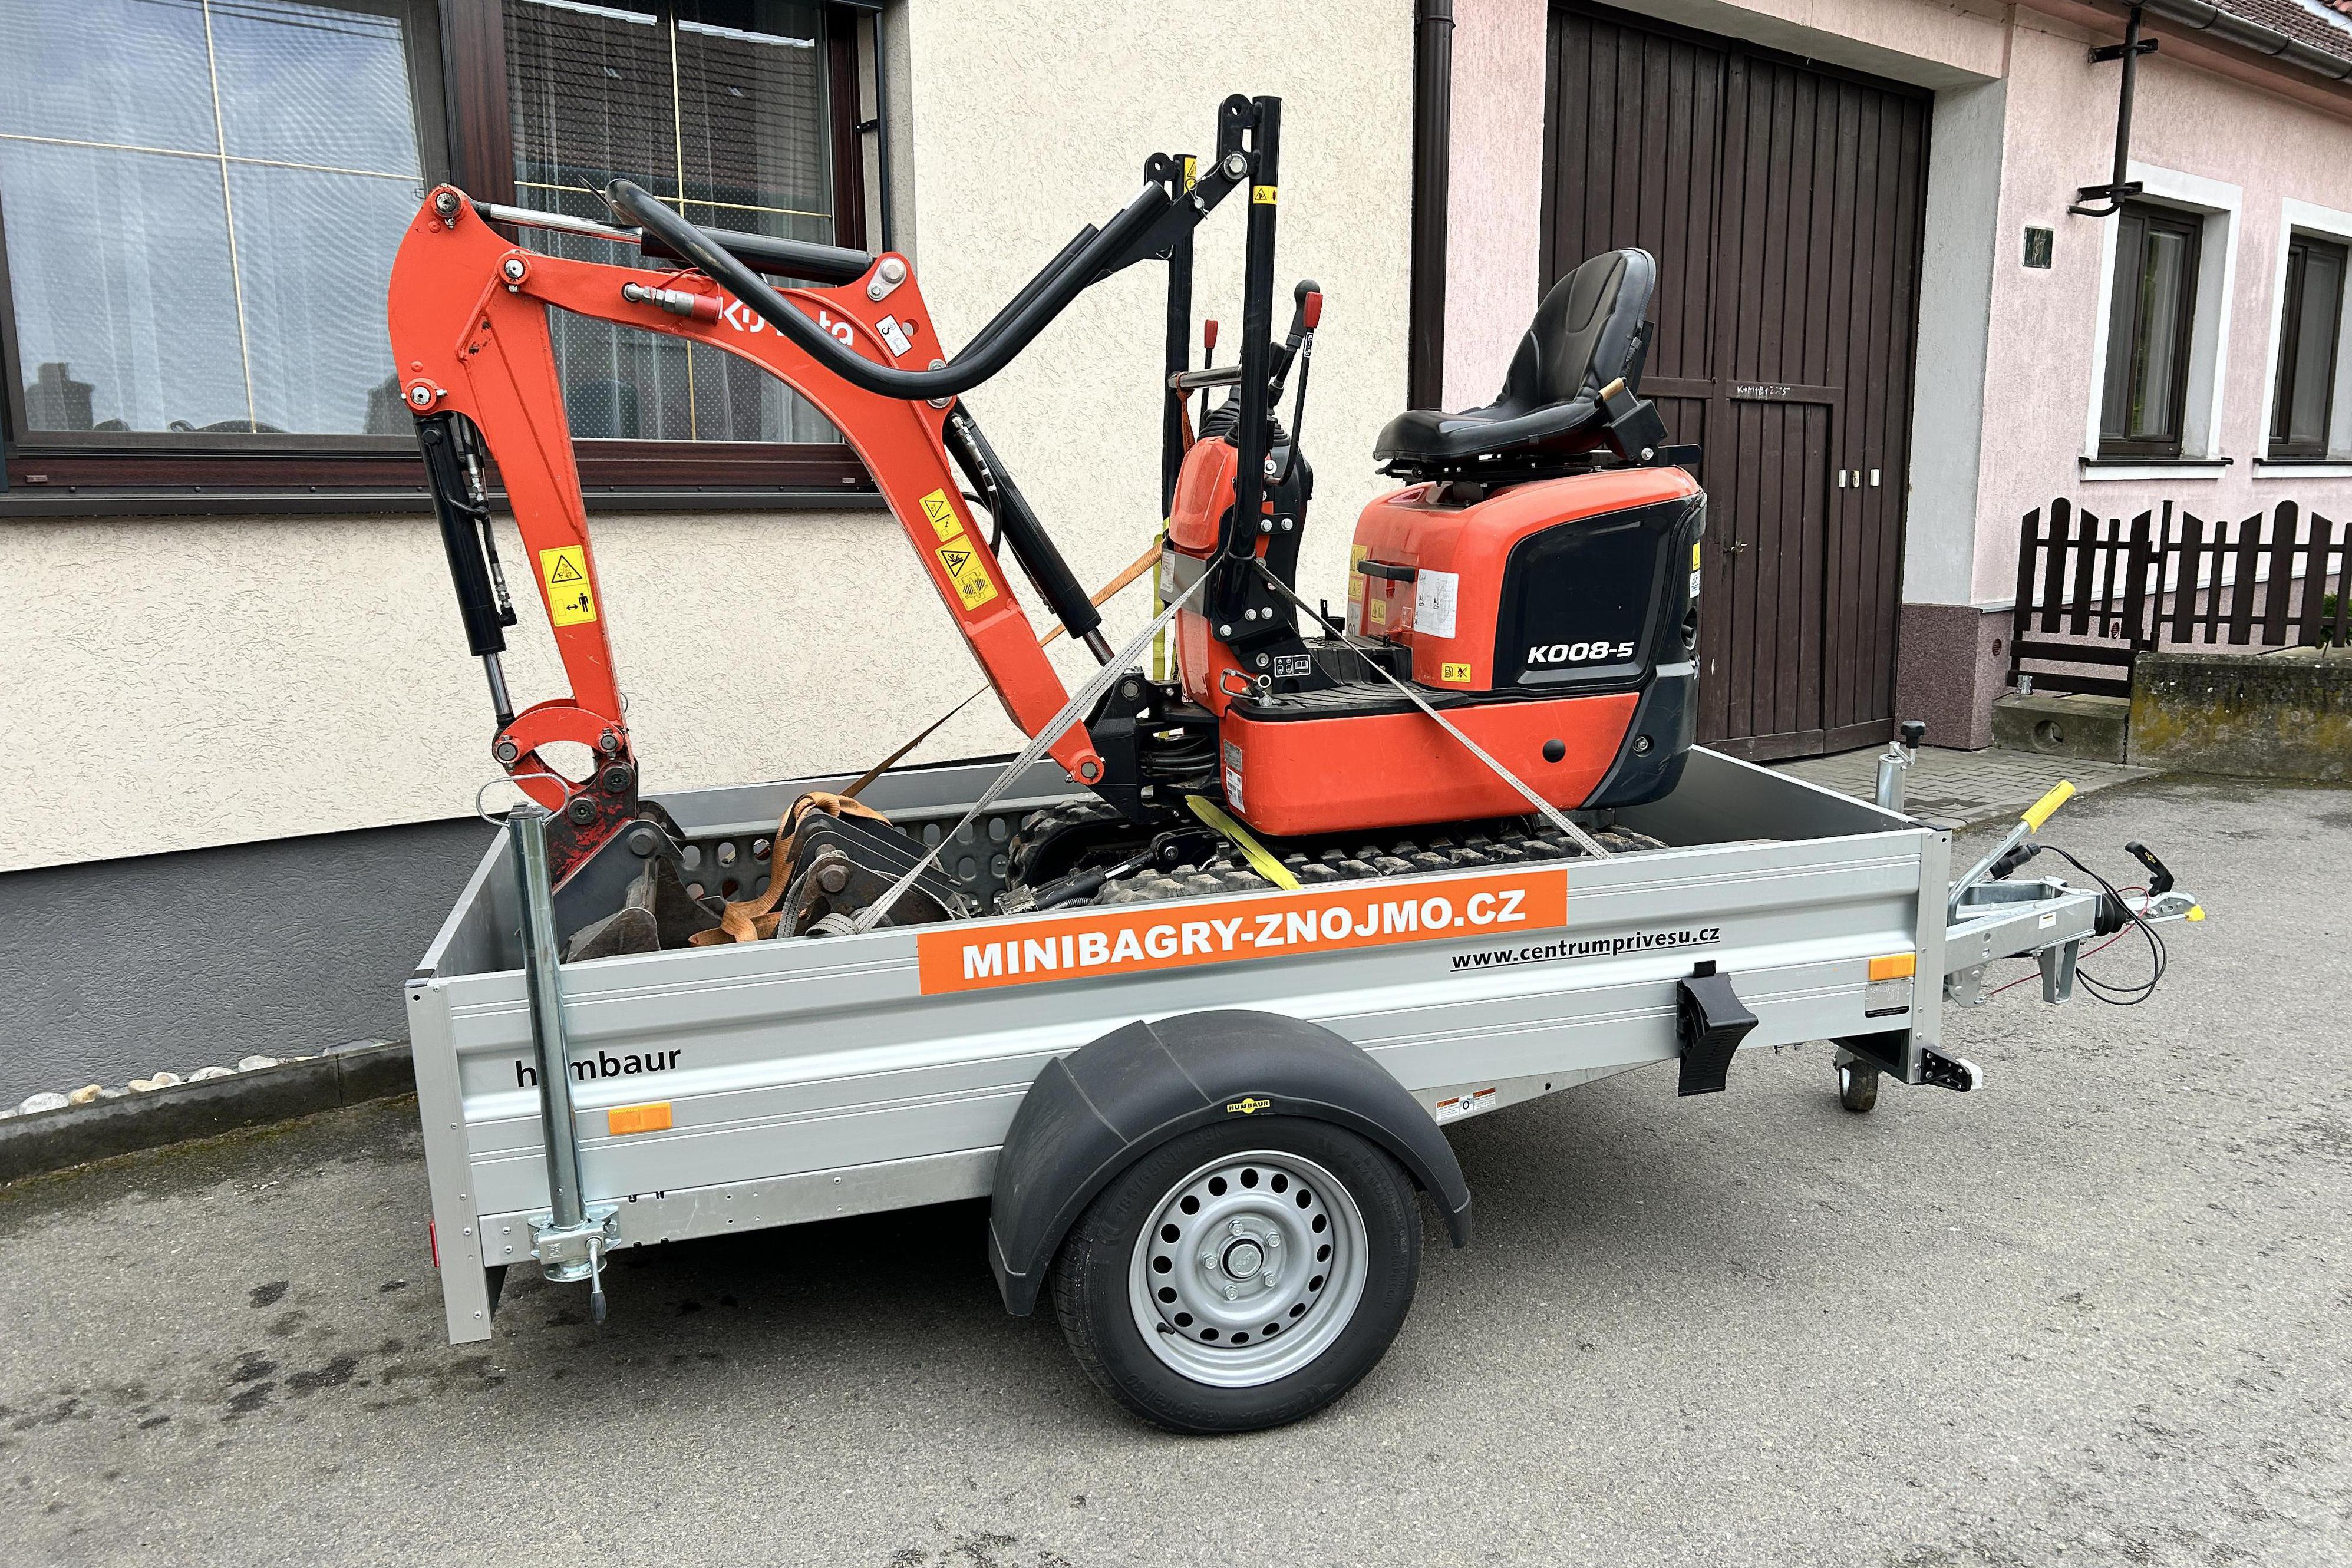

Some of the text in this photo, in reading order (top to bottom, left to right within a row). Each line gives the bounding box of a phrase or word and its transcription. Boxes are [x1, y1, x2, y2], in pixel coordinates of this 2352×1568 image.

[718, 296, 853, 346] Kuta
[1527, 641, 1635, 664] K008-5
[962, 889, 1526, 979] MINIBAGRY-ZNOJMO.CZ
[1451, 927, 1720, 970] www.centrumprivesu.cz
[515, 1049, 681, 1088] hmbaur
[1229, 1101, 1268, 1111] HUMBAUR
